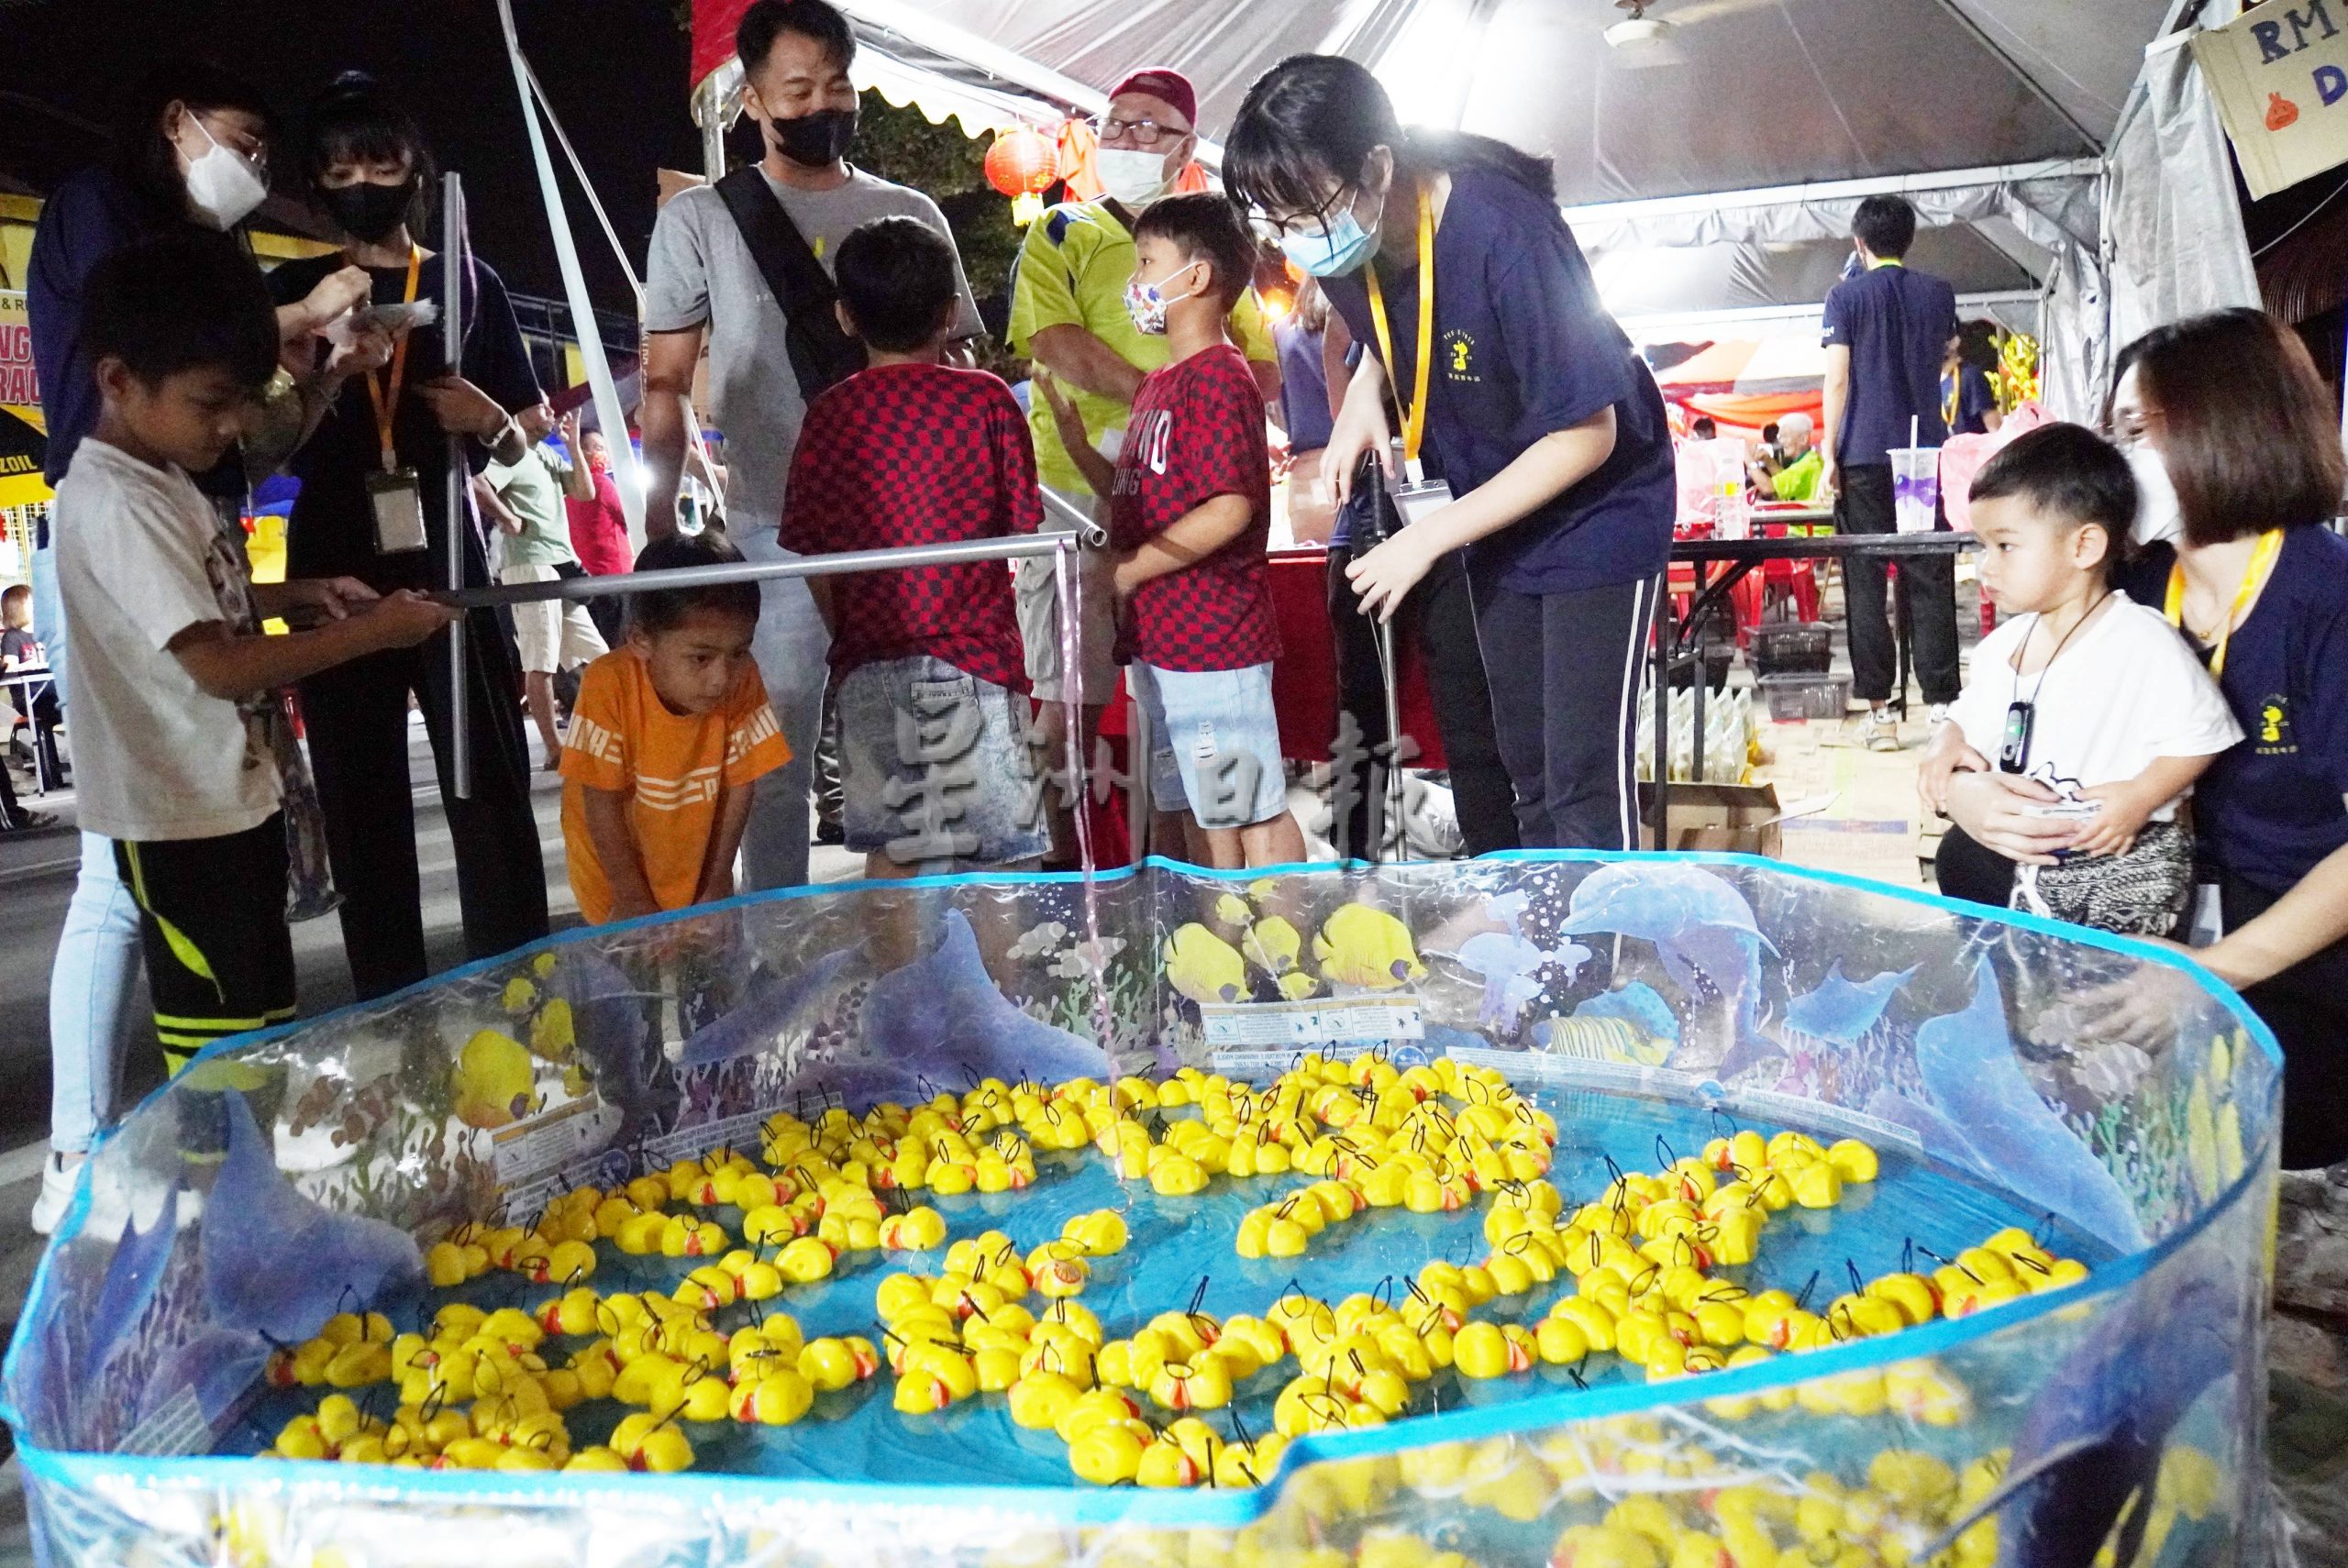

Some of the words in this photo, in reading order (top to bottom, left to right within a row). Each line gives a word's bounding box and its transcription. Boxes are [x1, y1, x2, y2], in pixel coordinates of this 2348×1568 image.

[2250, 0, 2340, 65] RM
[2312, 65, 2348, 106] D
[2, 297, 11, 310] &
